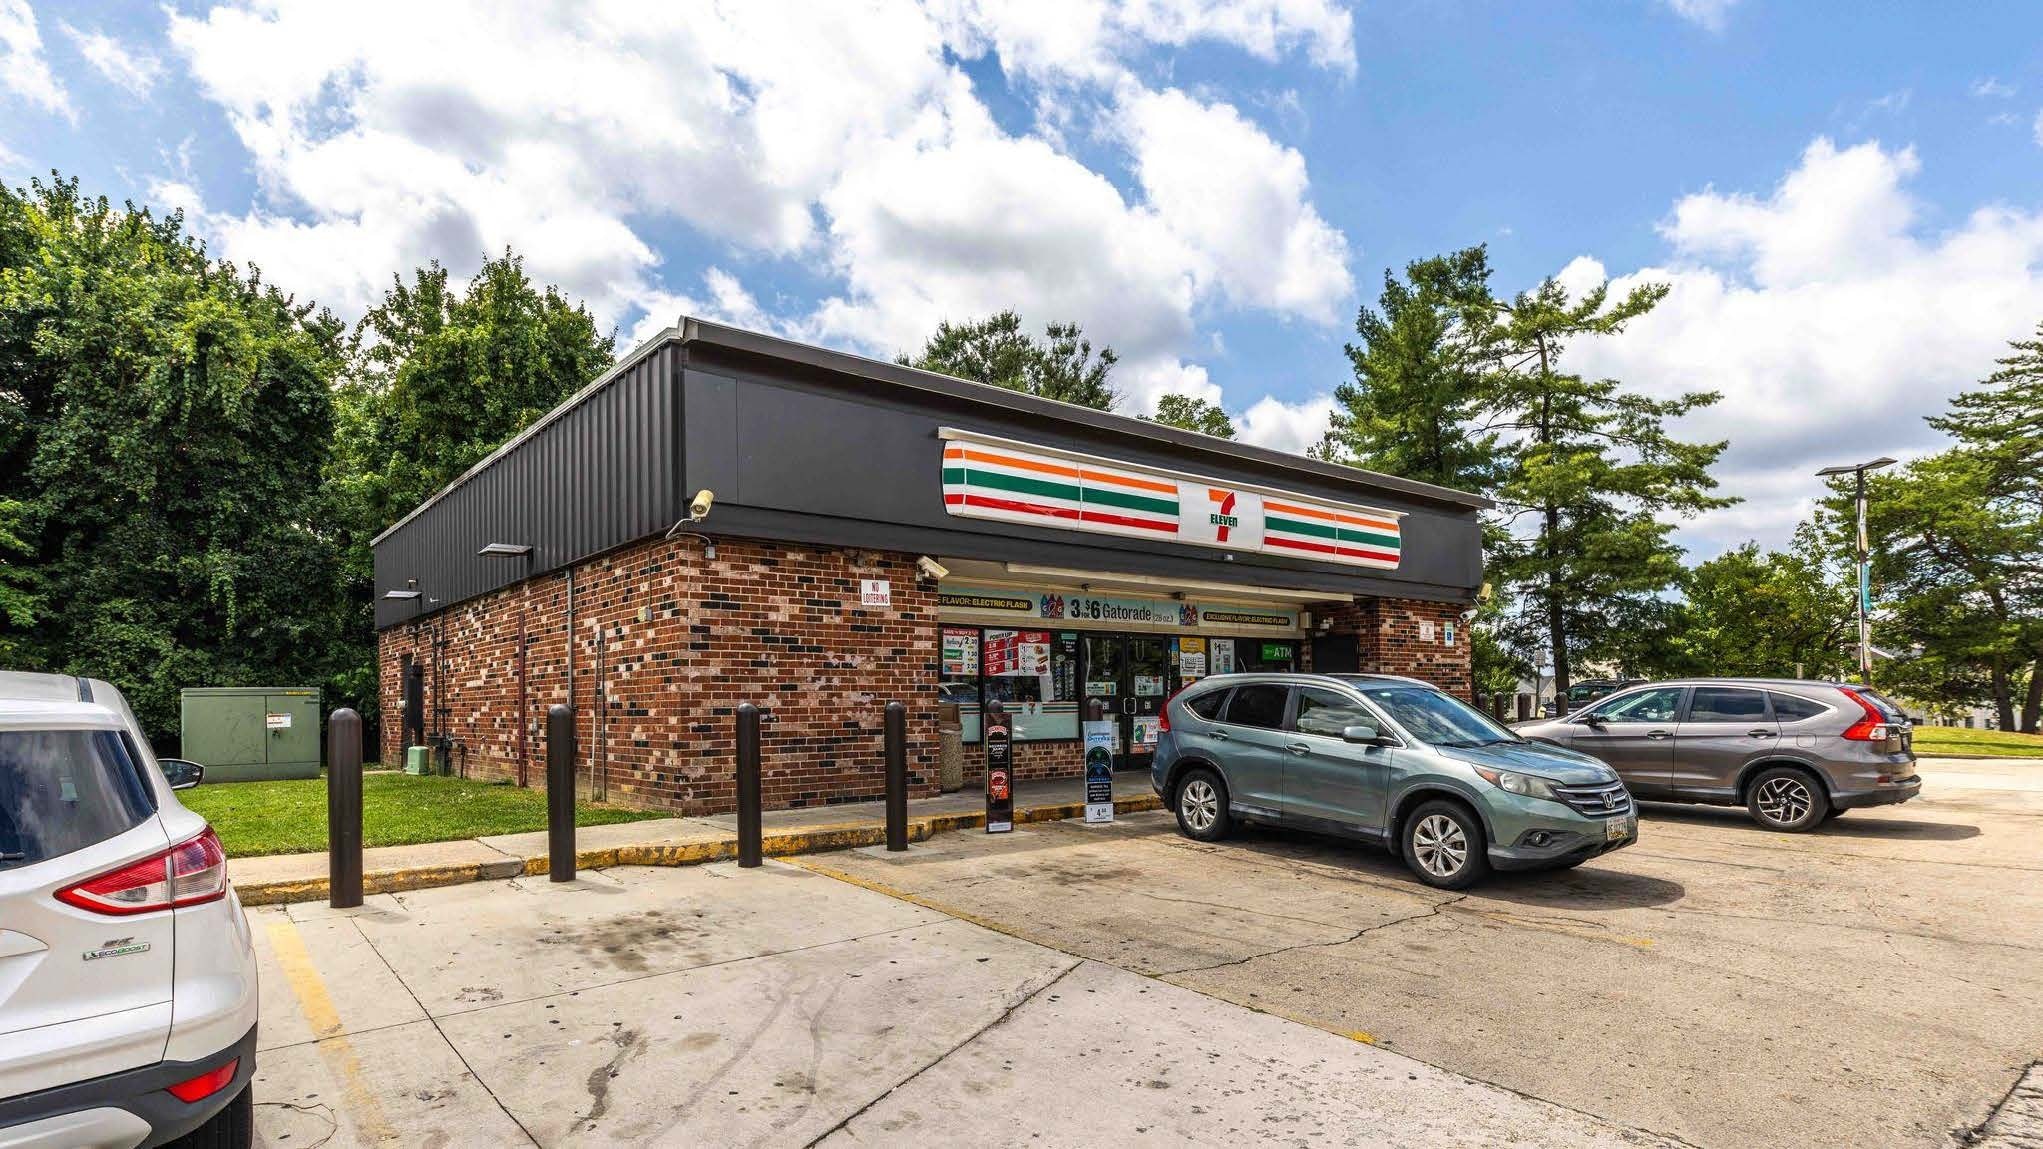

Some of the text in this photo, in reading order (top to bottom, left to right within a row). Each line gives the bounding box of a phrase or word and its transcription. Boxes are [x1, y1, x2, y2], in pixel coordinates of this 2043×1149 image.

[871, 582, 880, 592] NO
[863, 593, 888, 604] LOITERING
[942, 596, 972, 605] FLAVOR:
[972, 598, 1006, 608] ELECTRIC
[1006, 600, 1028, 609] FLASH
[1071, 599, 1081, 618] 3
[1102, 603, 1152, 621] Gatorade
[1274, 647, 1293, 658] ATM
